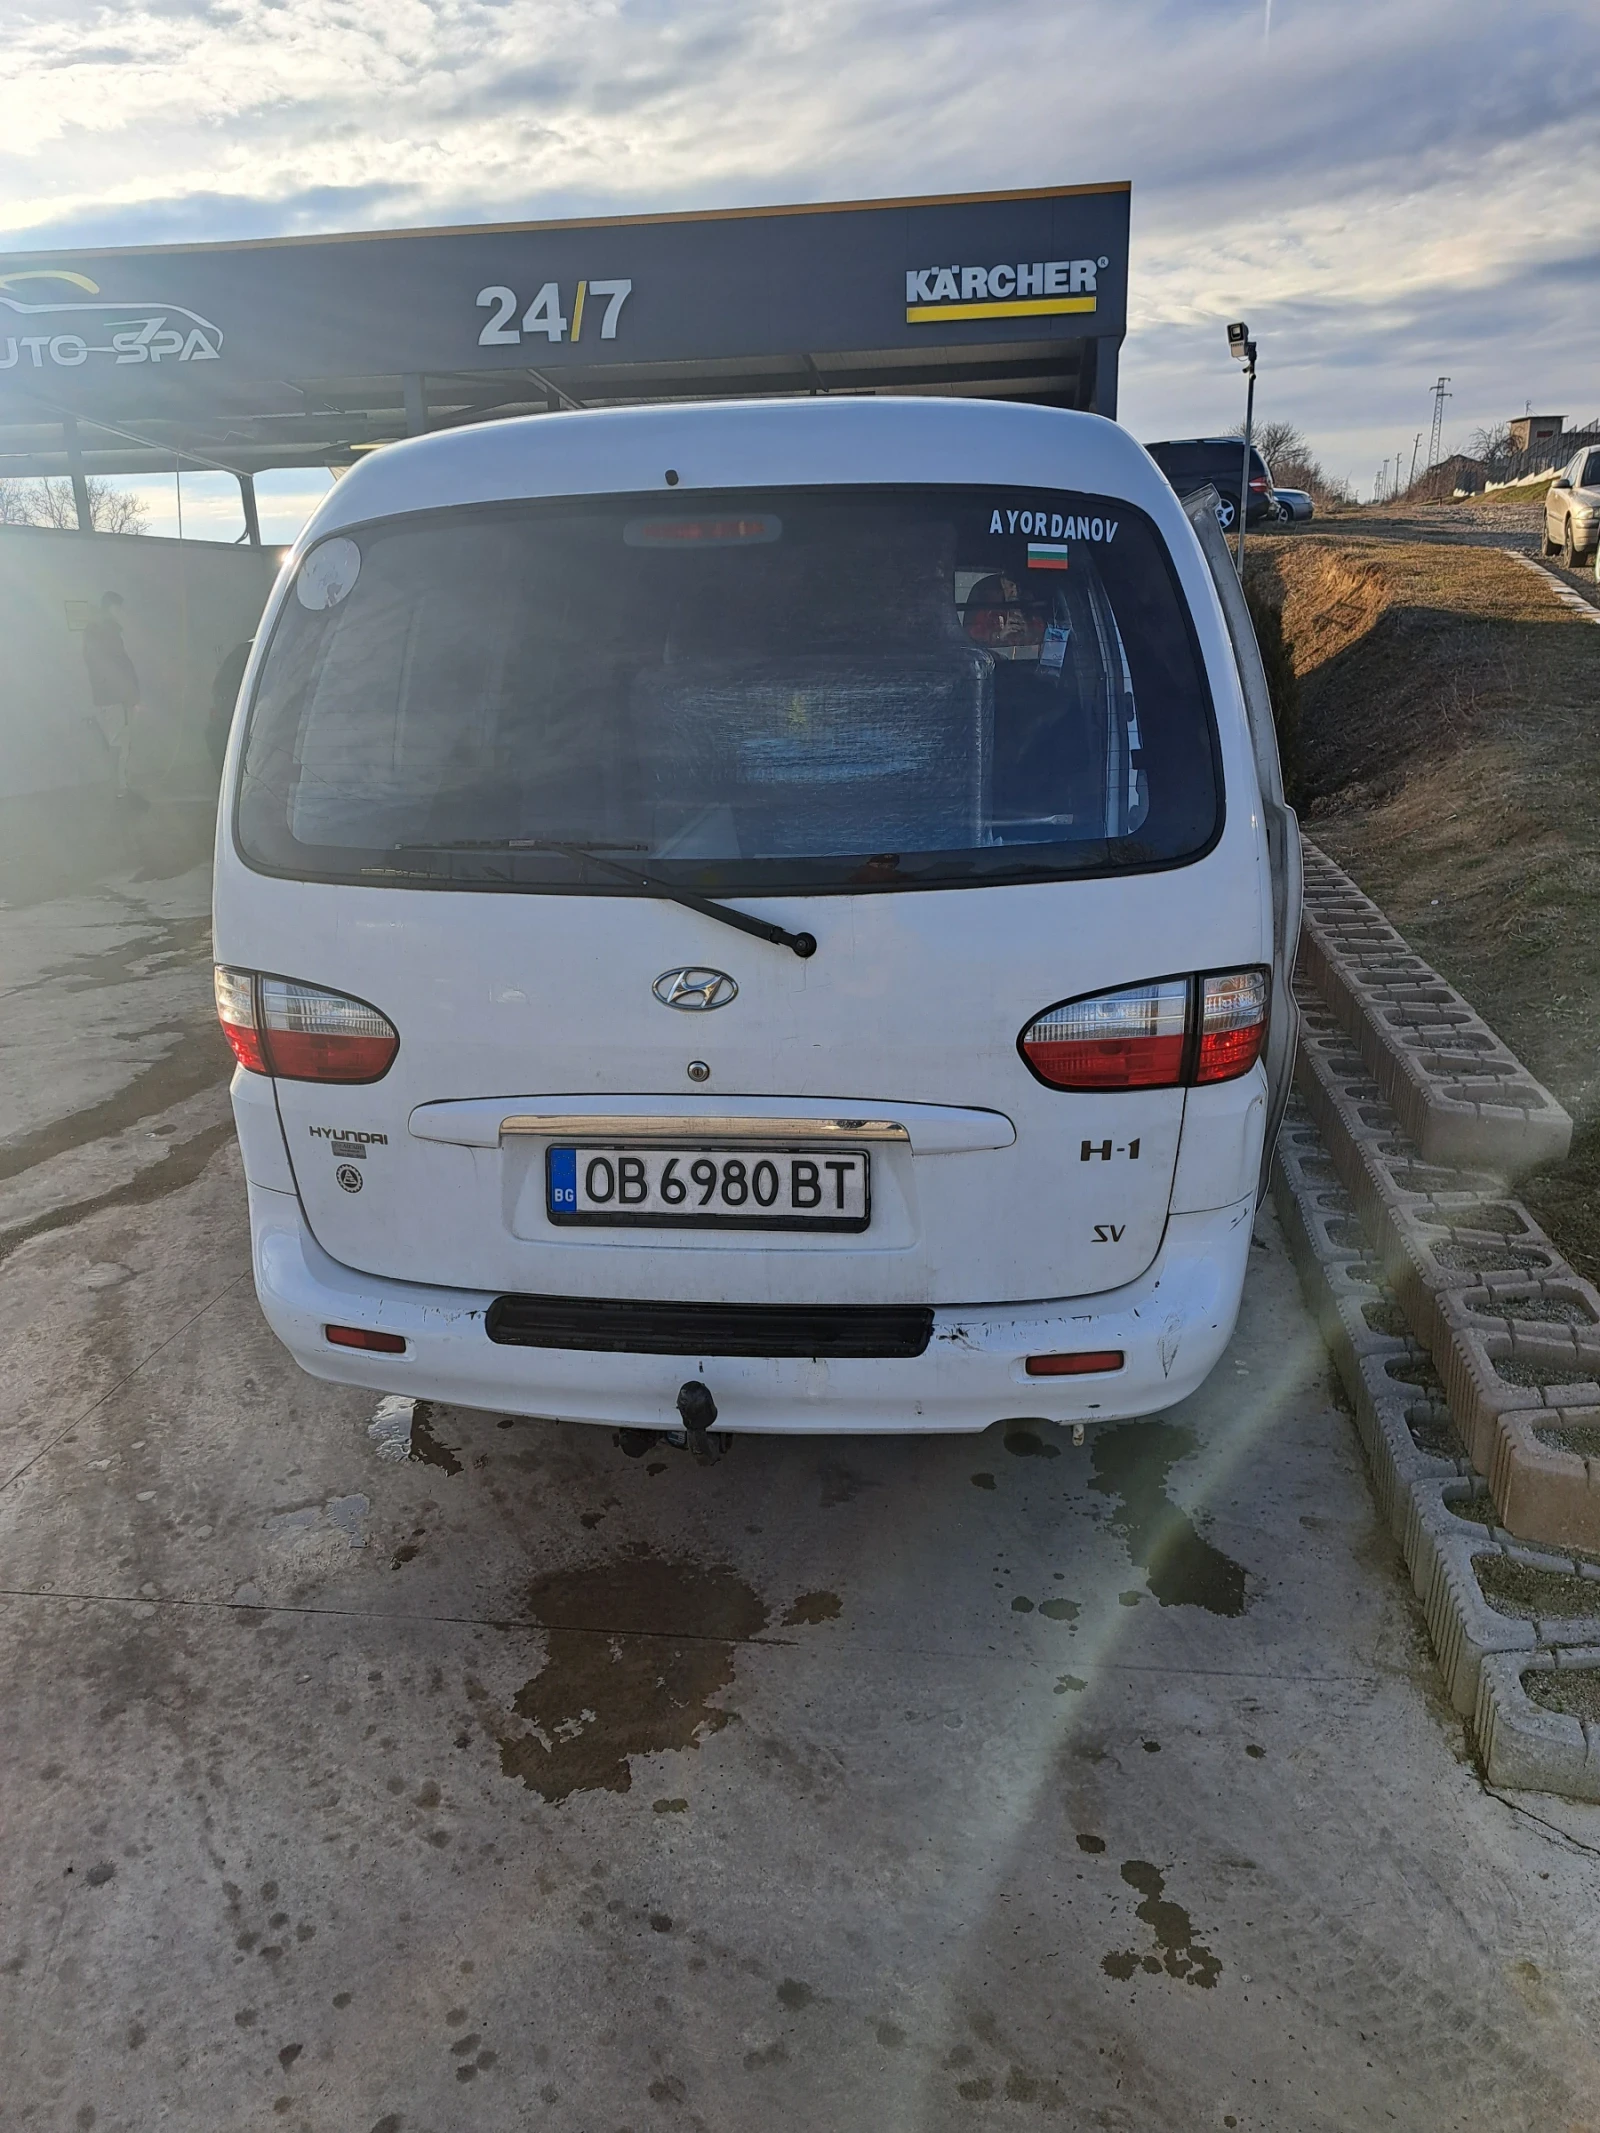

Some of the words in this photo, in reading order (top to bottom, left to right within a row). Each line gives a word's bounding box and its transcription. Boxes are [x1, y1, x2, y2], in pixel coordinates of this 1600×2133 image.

[475, 278, 632, 346] 24/7
[110, 318, 221, 364] SPA
[309, 1126, 388, 1145] HYUNDAI
[1080, 1138, 1140, 1161] H-1
[554, 1188, 574, 1203] BG
[1090, 1224, 1126, 1243] SV
